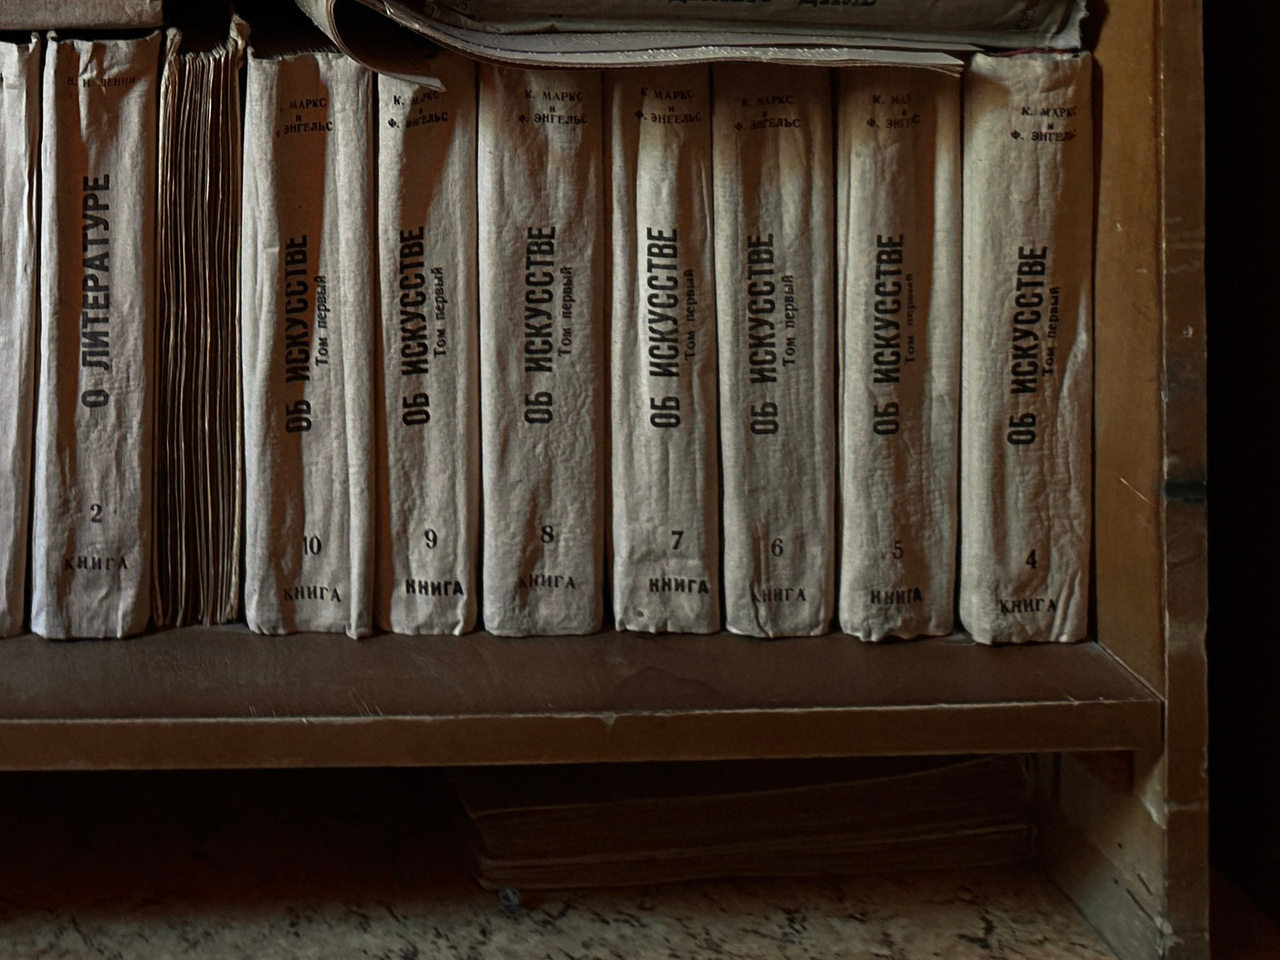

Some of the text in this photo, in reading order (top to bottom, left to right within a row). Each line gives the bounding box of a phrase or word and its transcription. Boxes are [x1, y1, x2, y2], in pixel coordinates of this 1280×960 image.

[81, 172, 111, 409] О ЛИТЕРАТУРЕ
[284, 234, 312, 434] ОБ ИСКУССТВЕ
[398, 225, 430, 426] ОБ ИСКУССТВЕ
[523, 225, 556, 425] ОБ ИСКУССТВЕ
[646, 226, 682, 429] ОБ ИСКУССТВЕ
[747, 233, 780, 436] ОБ ИСКУССТВЕ
[872, 233, 906, 437] ОБ ИСКУССТВЕ
[1006, 245, 1049, 446] ОБ ИСКУССТВЕ
[89, 503, 103, 524] 2
[423, 528, 438, 549] 9
[540, 524, 554, 544] 8
[671, 530, 685, 551] 7
[303, 535, 322, 556] 10
[770, 537, 785, 557] 6
[65, 555, 129, 571] КНИГА
[1024, 549, 1038, 570] 4
[405, 578, 465, 597] КНИГА
[648, 576, 710, 595] КНИГА
[999, 598, 1058, 614] КНИГА
